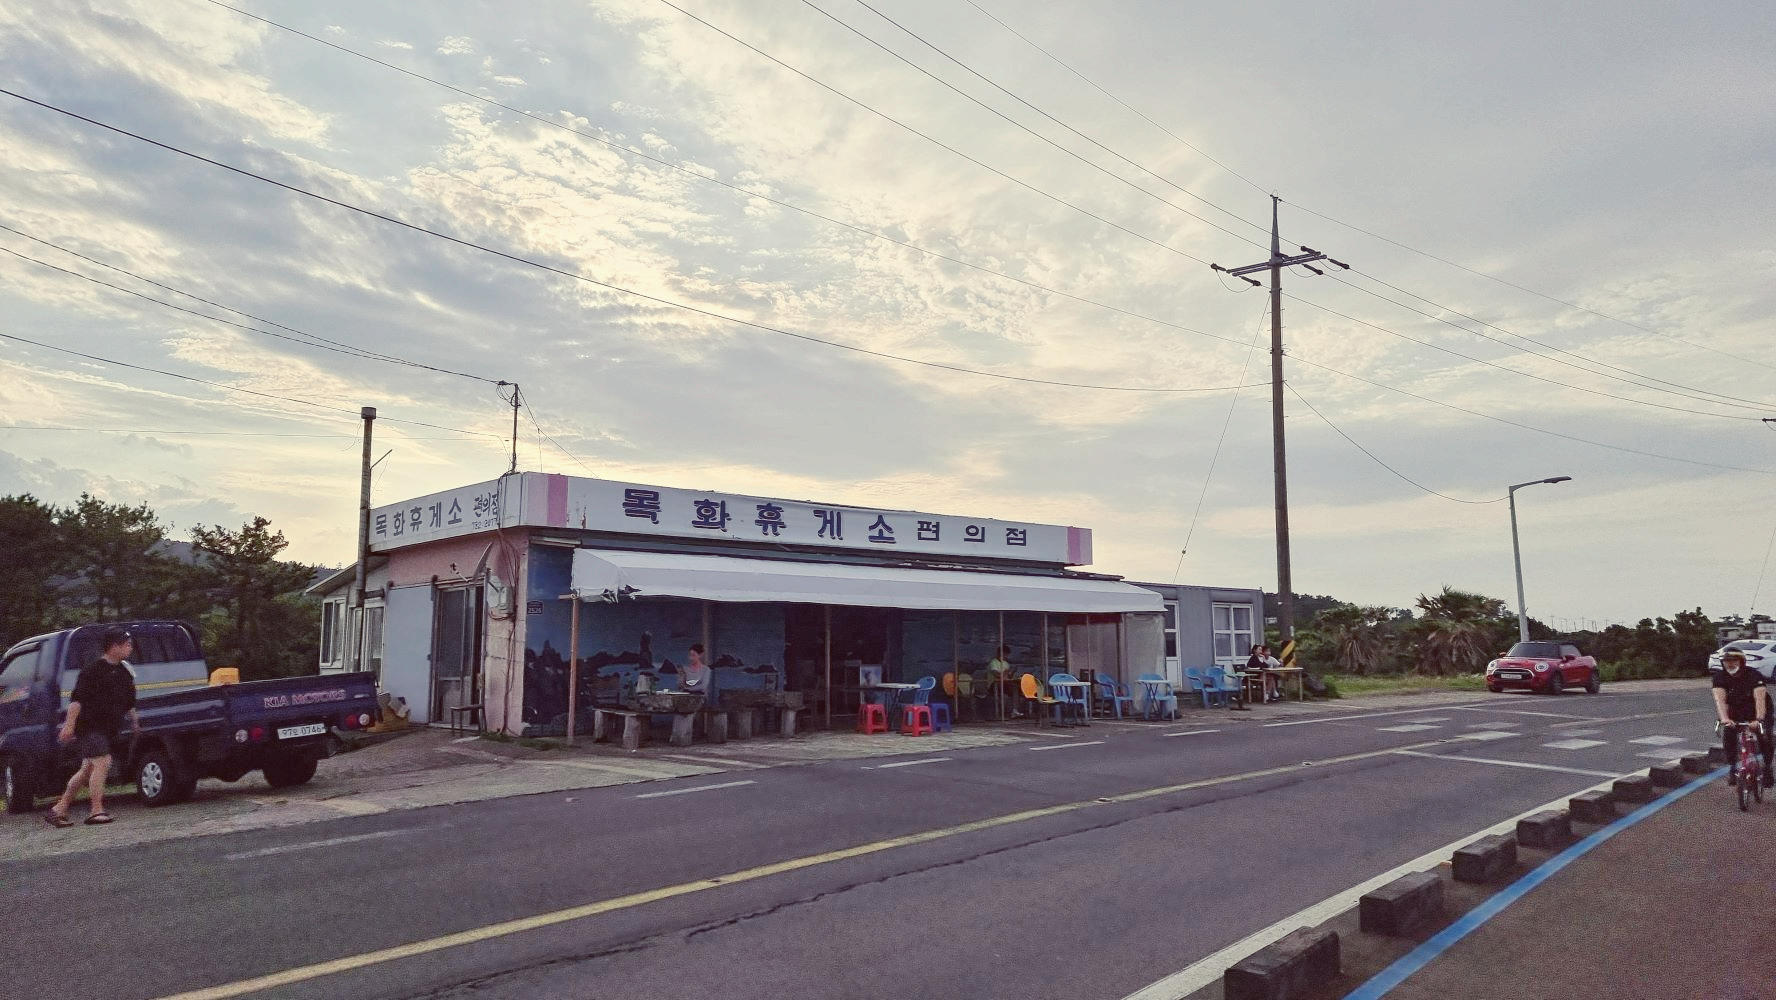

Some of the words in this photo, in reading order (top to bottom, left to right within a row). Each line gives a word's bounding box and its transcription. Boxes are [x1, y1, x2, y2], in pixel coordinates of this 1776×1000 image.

[376, 497, 463, 538] 목화휴게소
[622, 487, 896, 544] 목화휴게소
[916, 519, 1028, 547] 편의점
[264, 695, 289, 708] KIA
[291, 689, 346, 705] MOTORS
